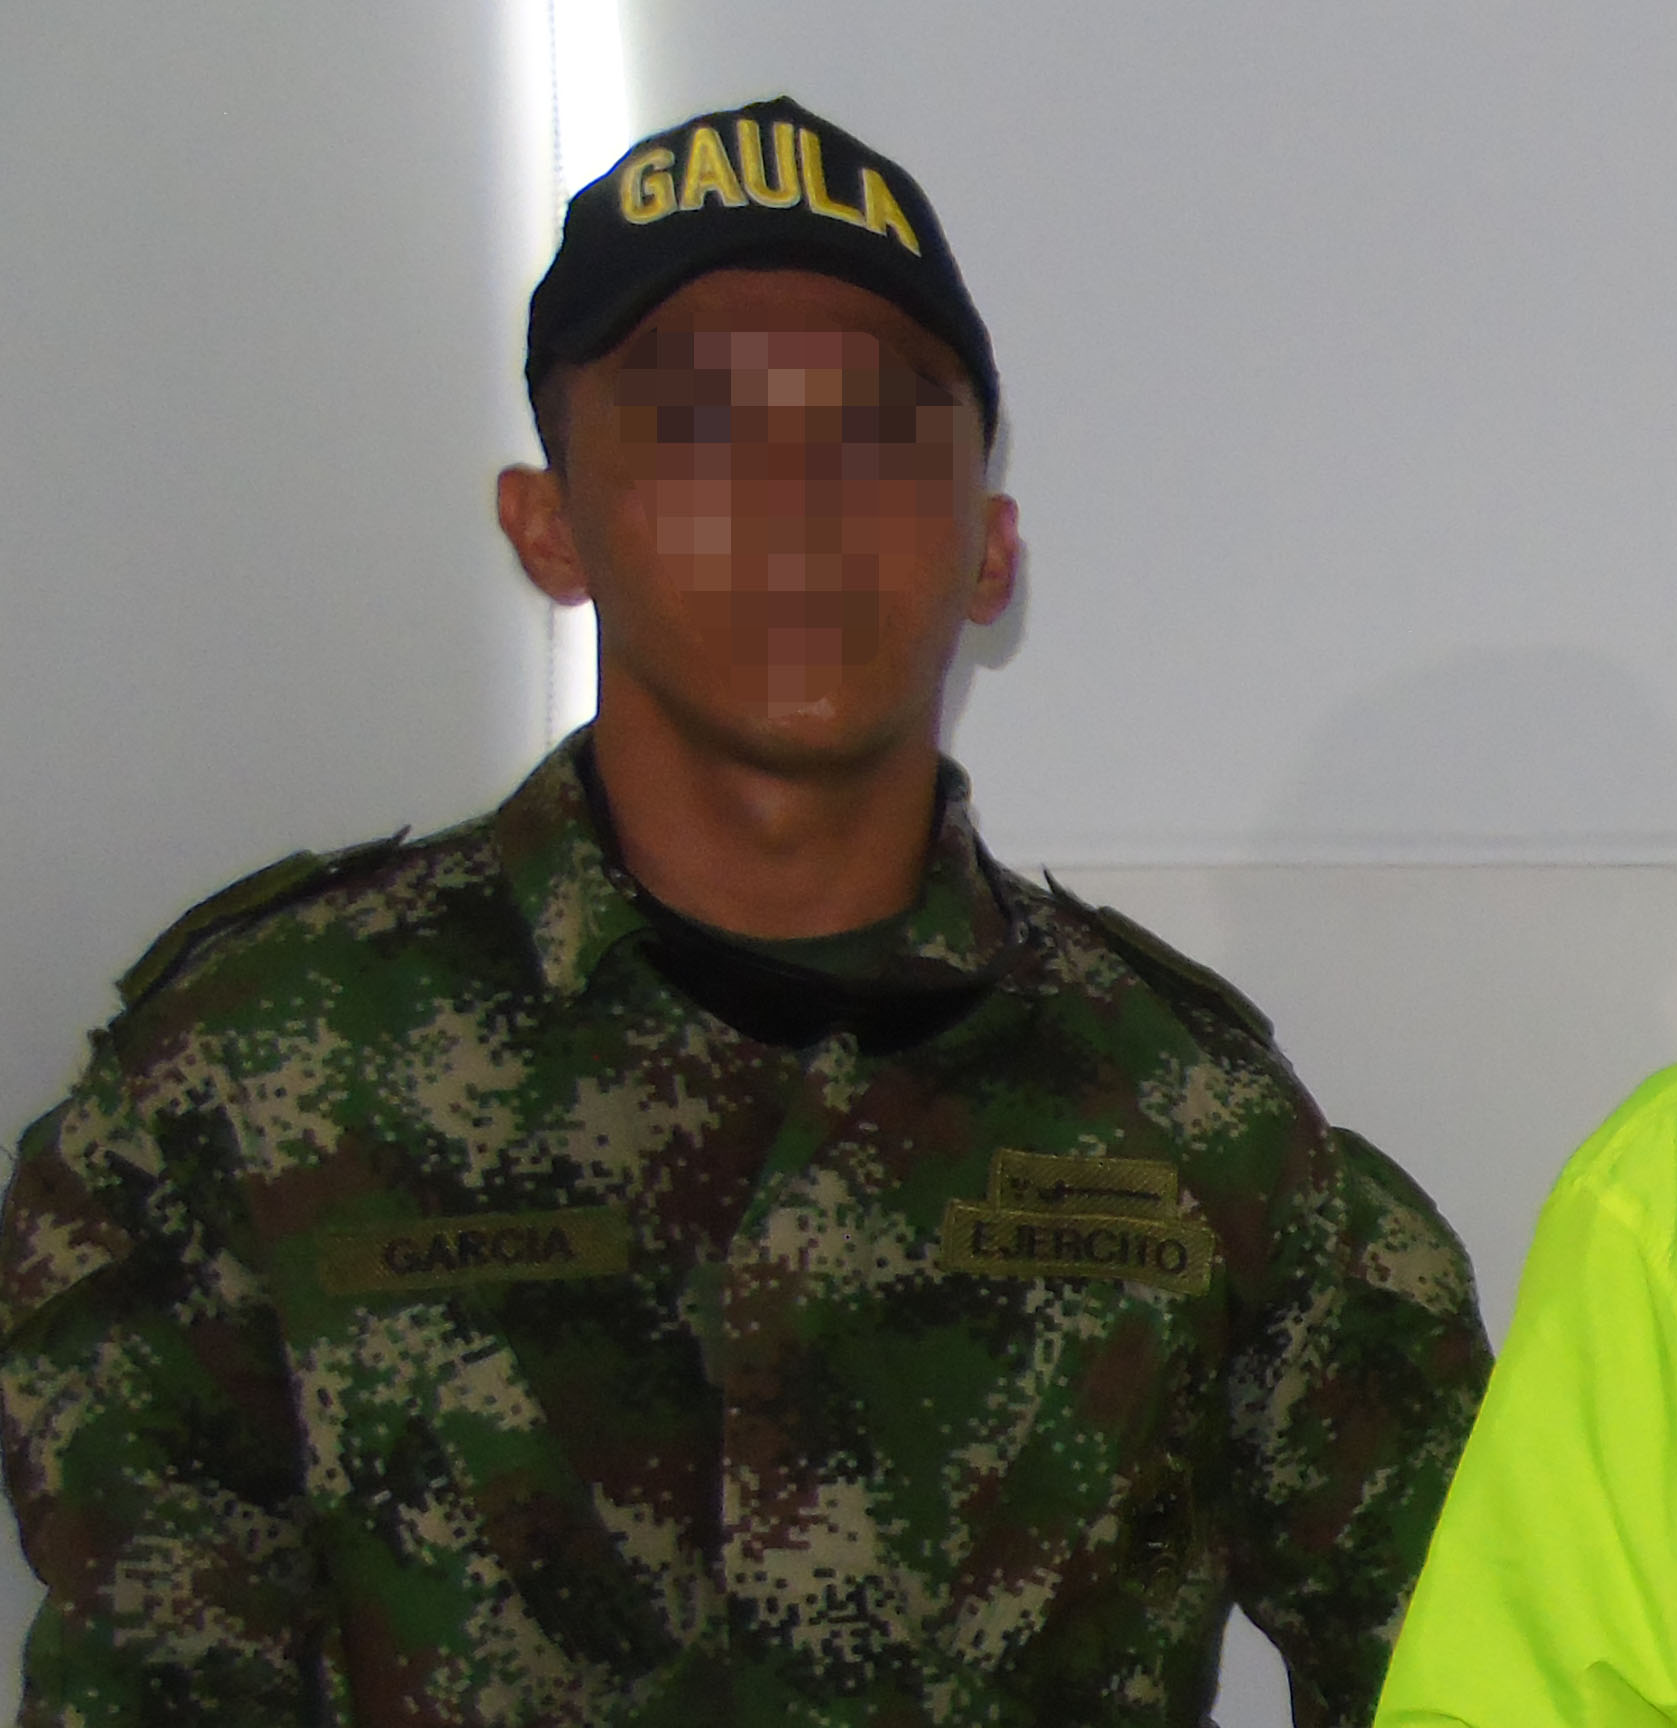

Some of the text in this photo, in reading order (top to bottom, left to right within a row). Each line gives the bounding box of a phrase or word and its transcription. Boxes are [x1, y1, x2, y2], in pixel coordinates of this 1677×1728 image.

[620, 118, 922, 258] GAULA
[384, 1226, 576, 1275] GARCIA
[973, 1220, 1187, 1275] EJERCITO
